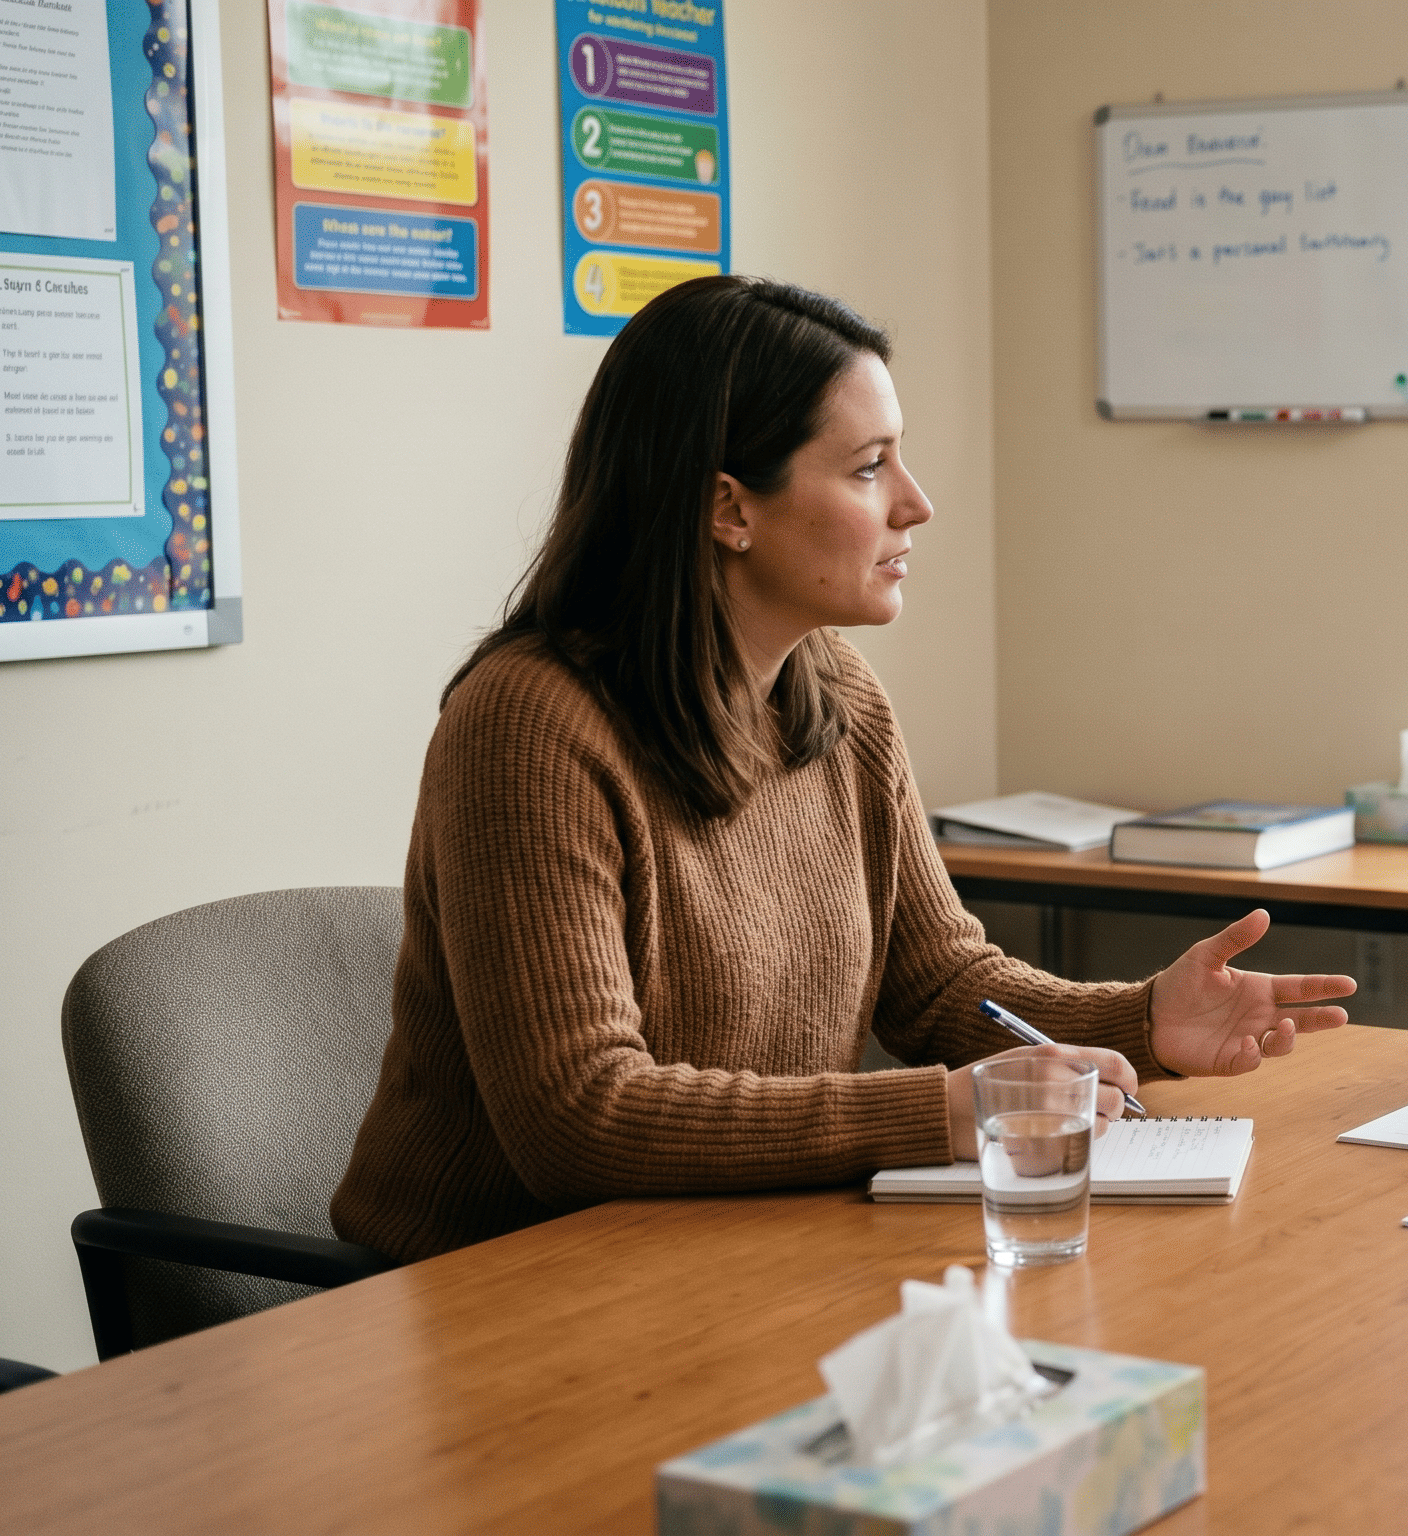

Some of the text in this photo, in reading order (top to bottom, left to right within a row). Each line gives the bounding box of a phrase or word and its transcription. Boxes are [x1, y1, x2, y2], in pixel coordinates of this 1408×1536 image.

[581, 44, 596, 86] 1
[582, 116, 602, 159] 2
[583, 190, 603, 230] 3
[584, 263, 605, 304] 4
